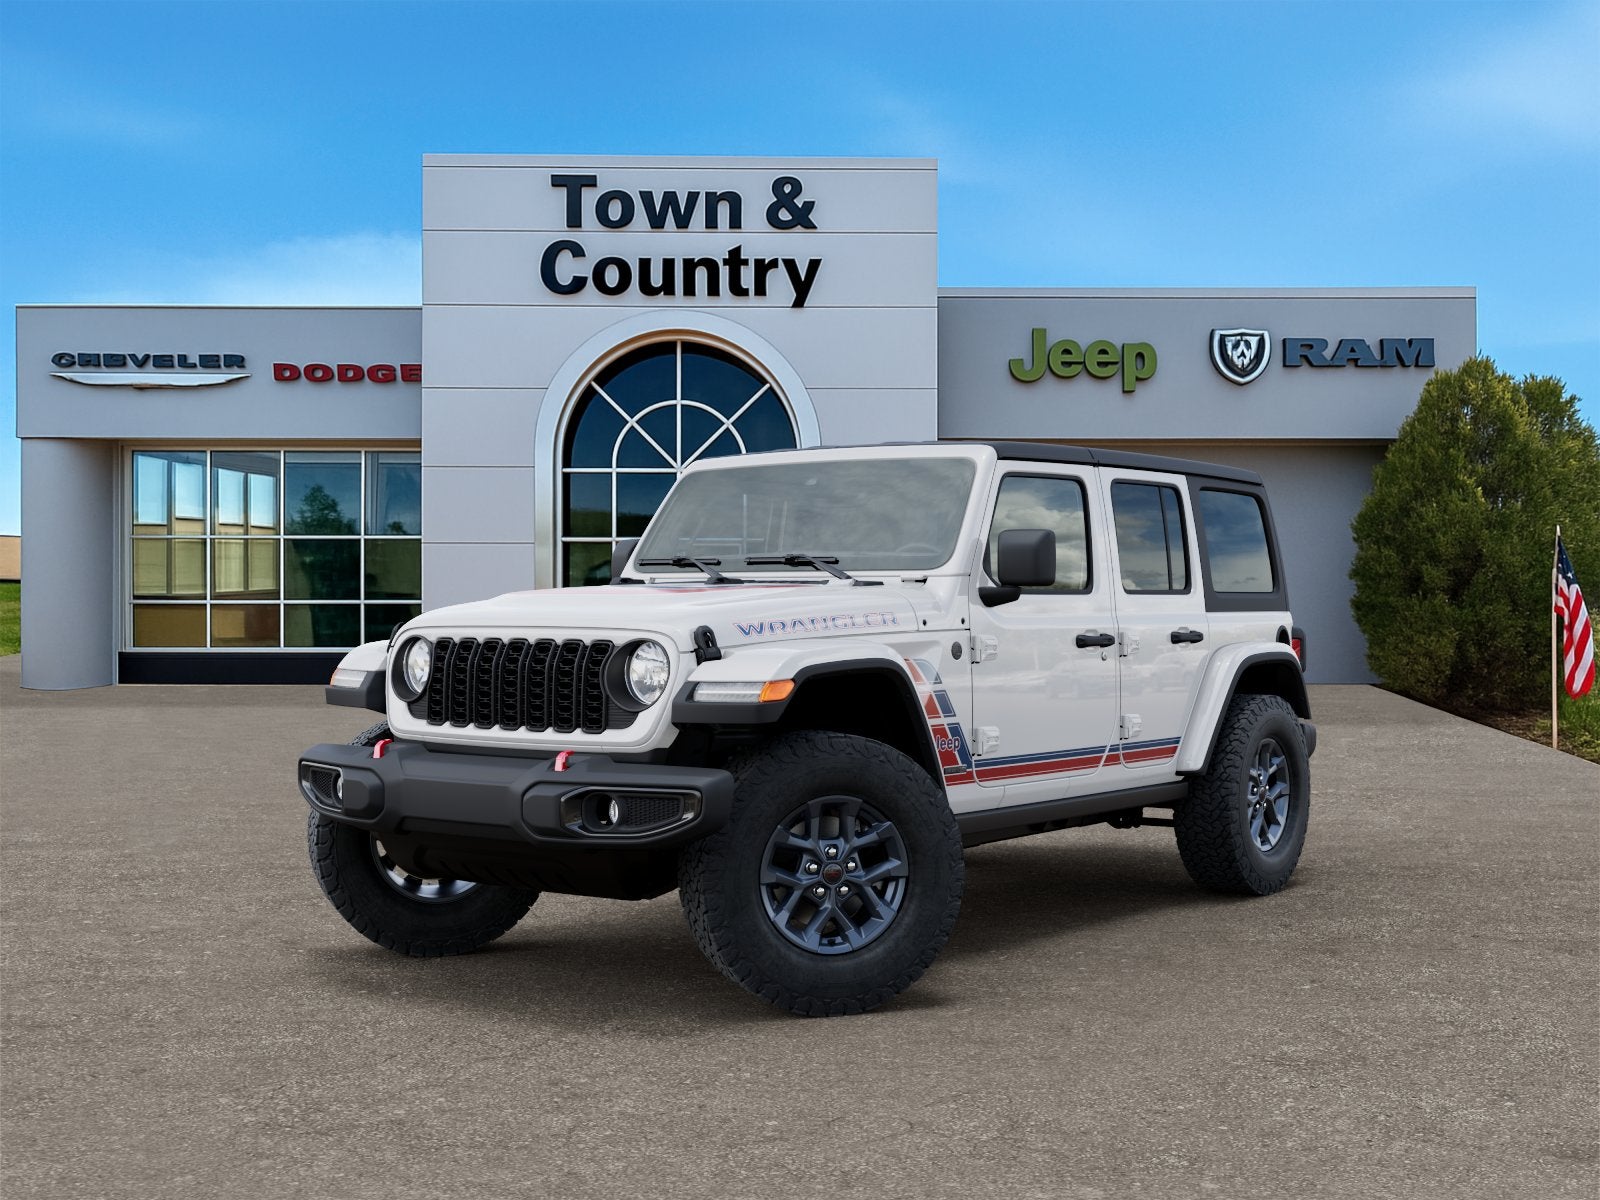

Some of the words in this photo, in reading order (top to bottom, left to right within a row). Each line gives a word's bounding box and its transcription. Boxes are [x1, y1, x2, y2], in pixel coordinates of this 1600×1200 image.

[550, 174, 743, 229] Town
[765, 176, 818, 230] &
[540, 239, 822, 308] Country
[272, 362, 422, 383] DODGE
[1009, 327, 1157, 392] Jeep
[1282, 337, 1435, 367] RAM
[733, 611, 900, 637] WRANGLER
